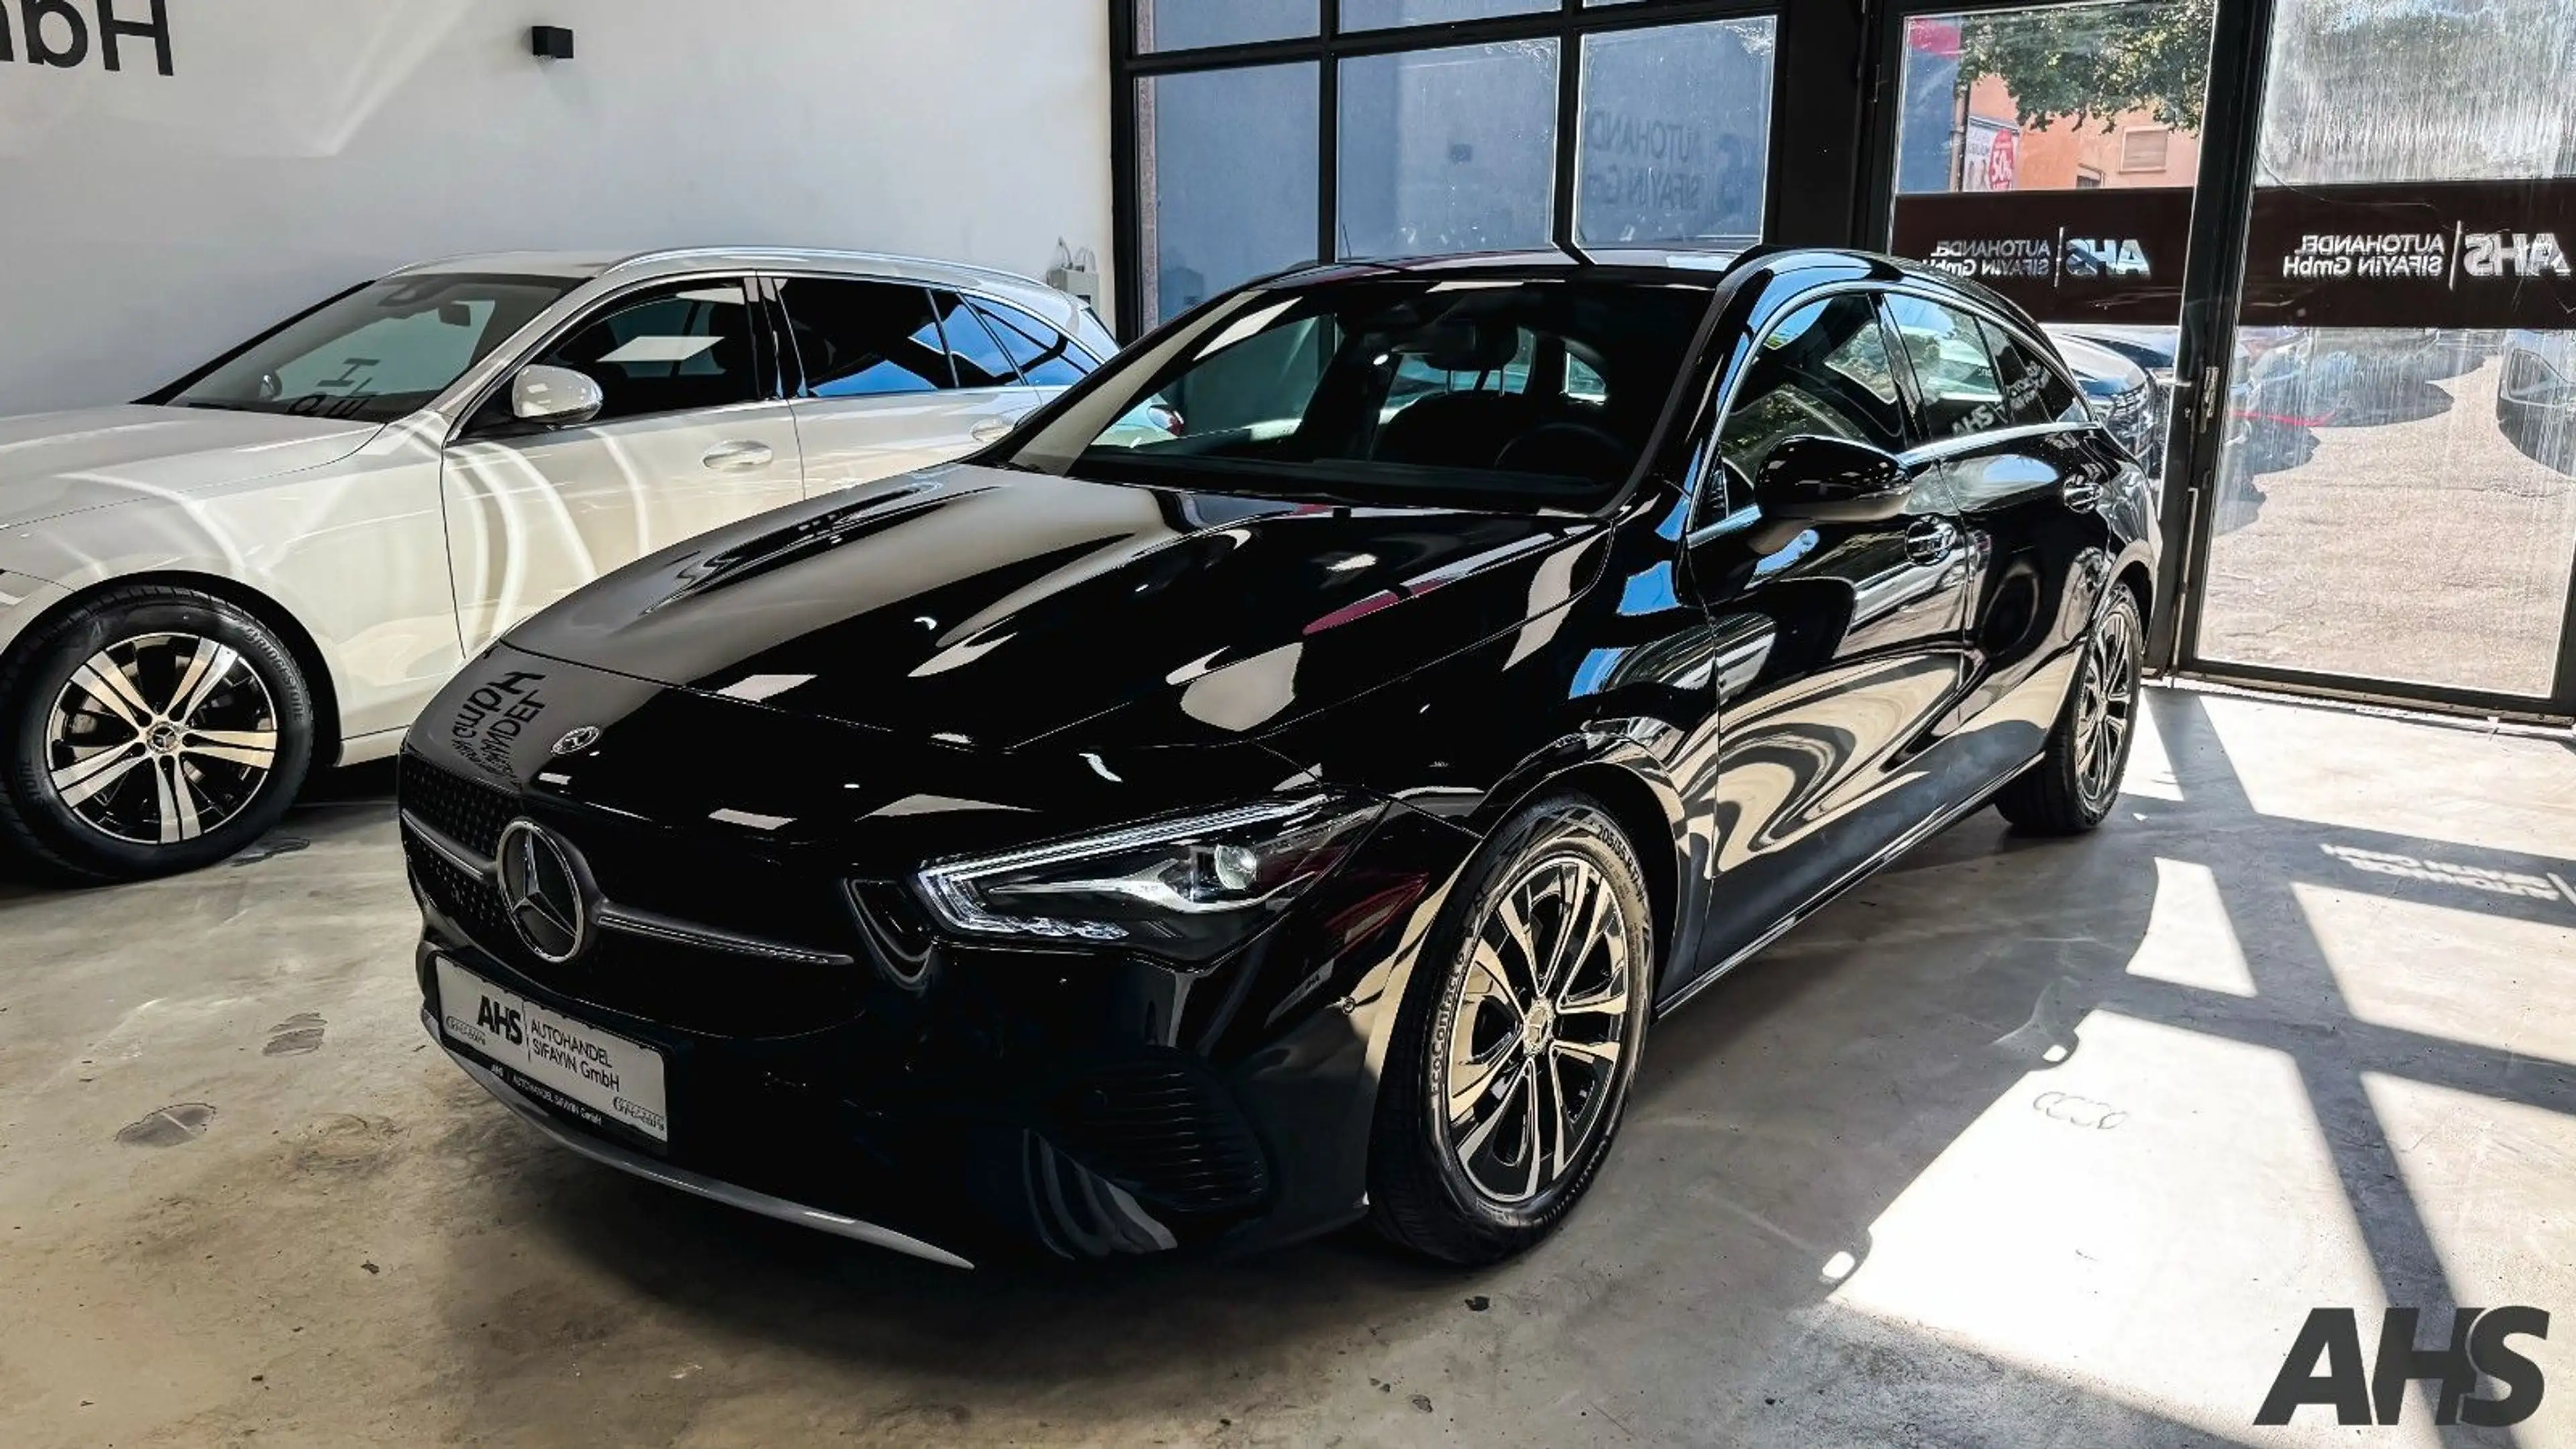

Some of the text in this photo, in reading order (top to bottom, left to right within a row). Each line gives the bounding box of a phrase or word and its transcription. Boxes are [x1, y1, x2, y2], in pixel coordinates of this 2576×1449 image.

[0, 0, 174, 76] bH
[476, 994, 523, 1045] AHS
[531, 1018, 613, 1069] AUTOHANDEL
[532, 1038, 621, 1093] SIFAYIN GmbH
